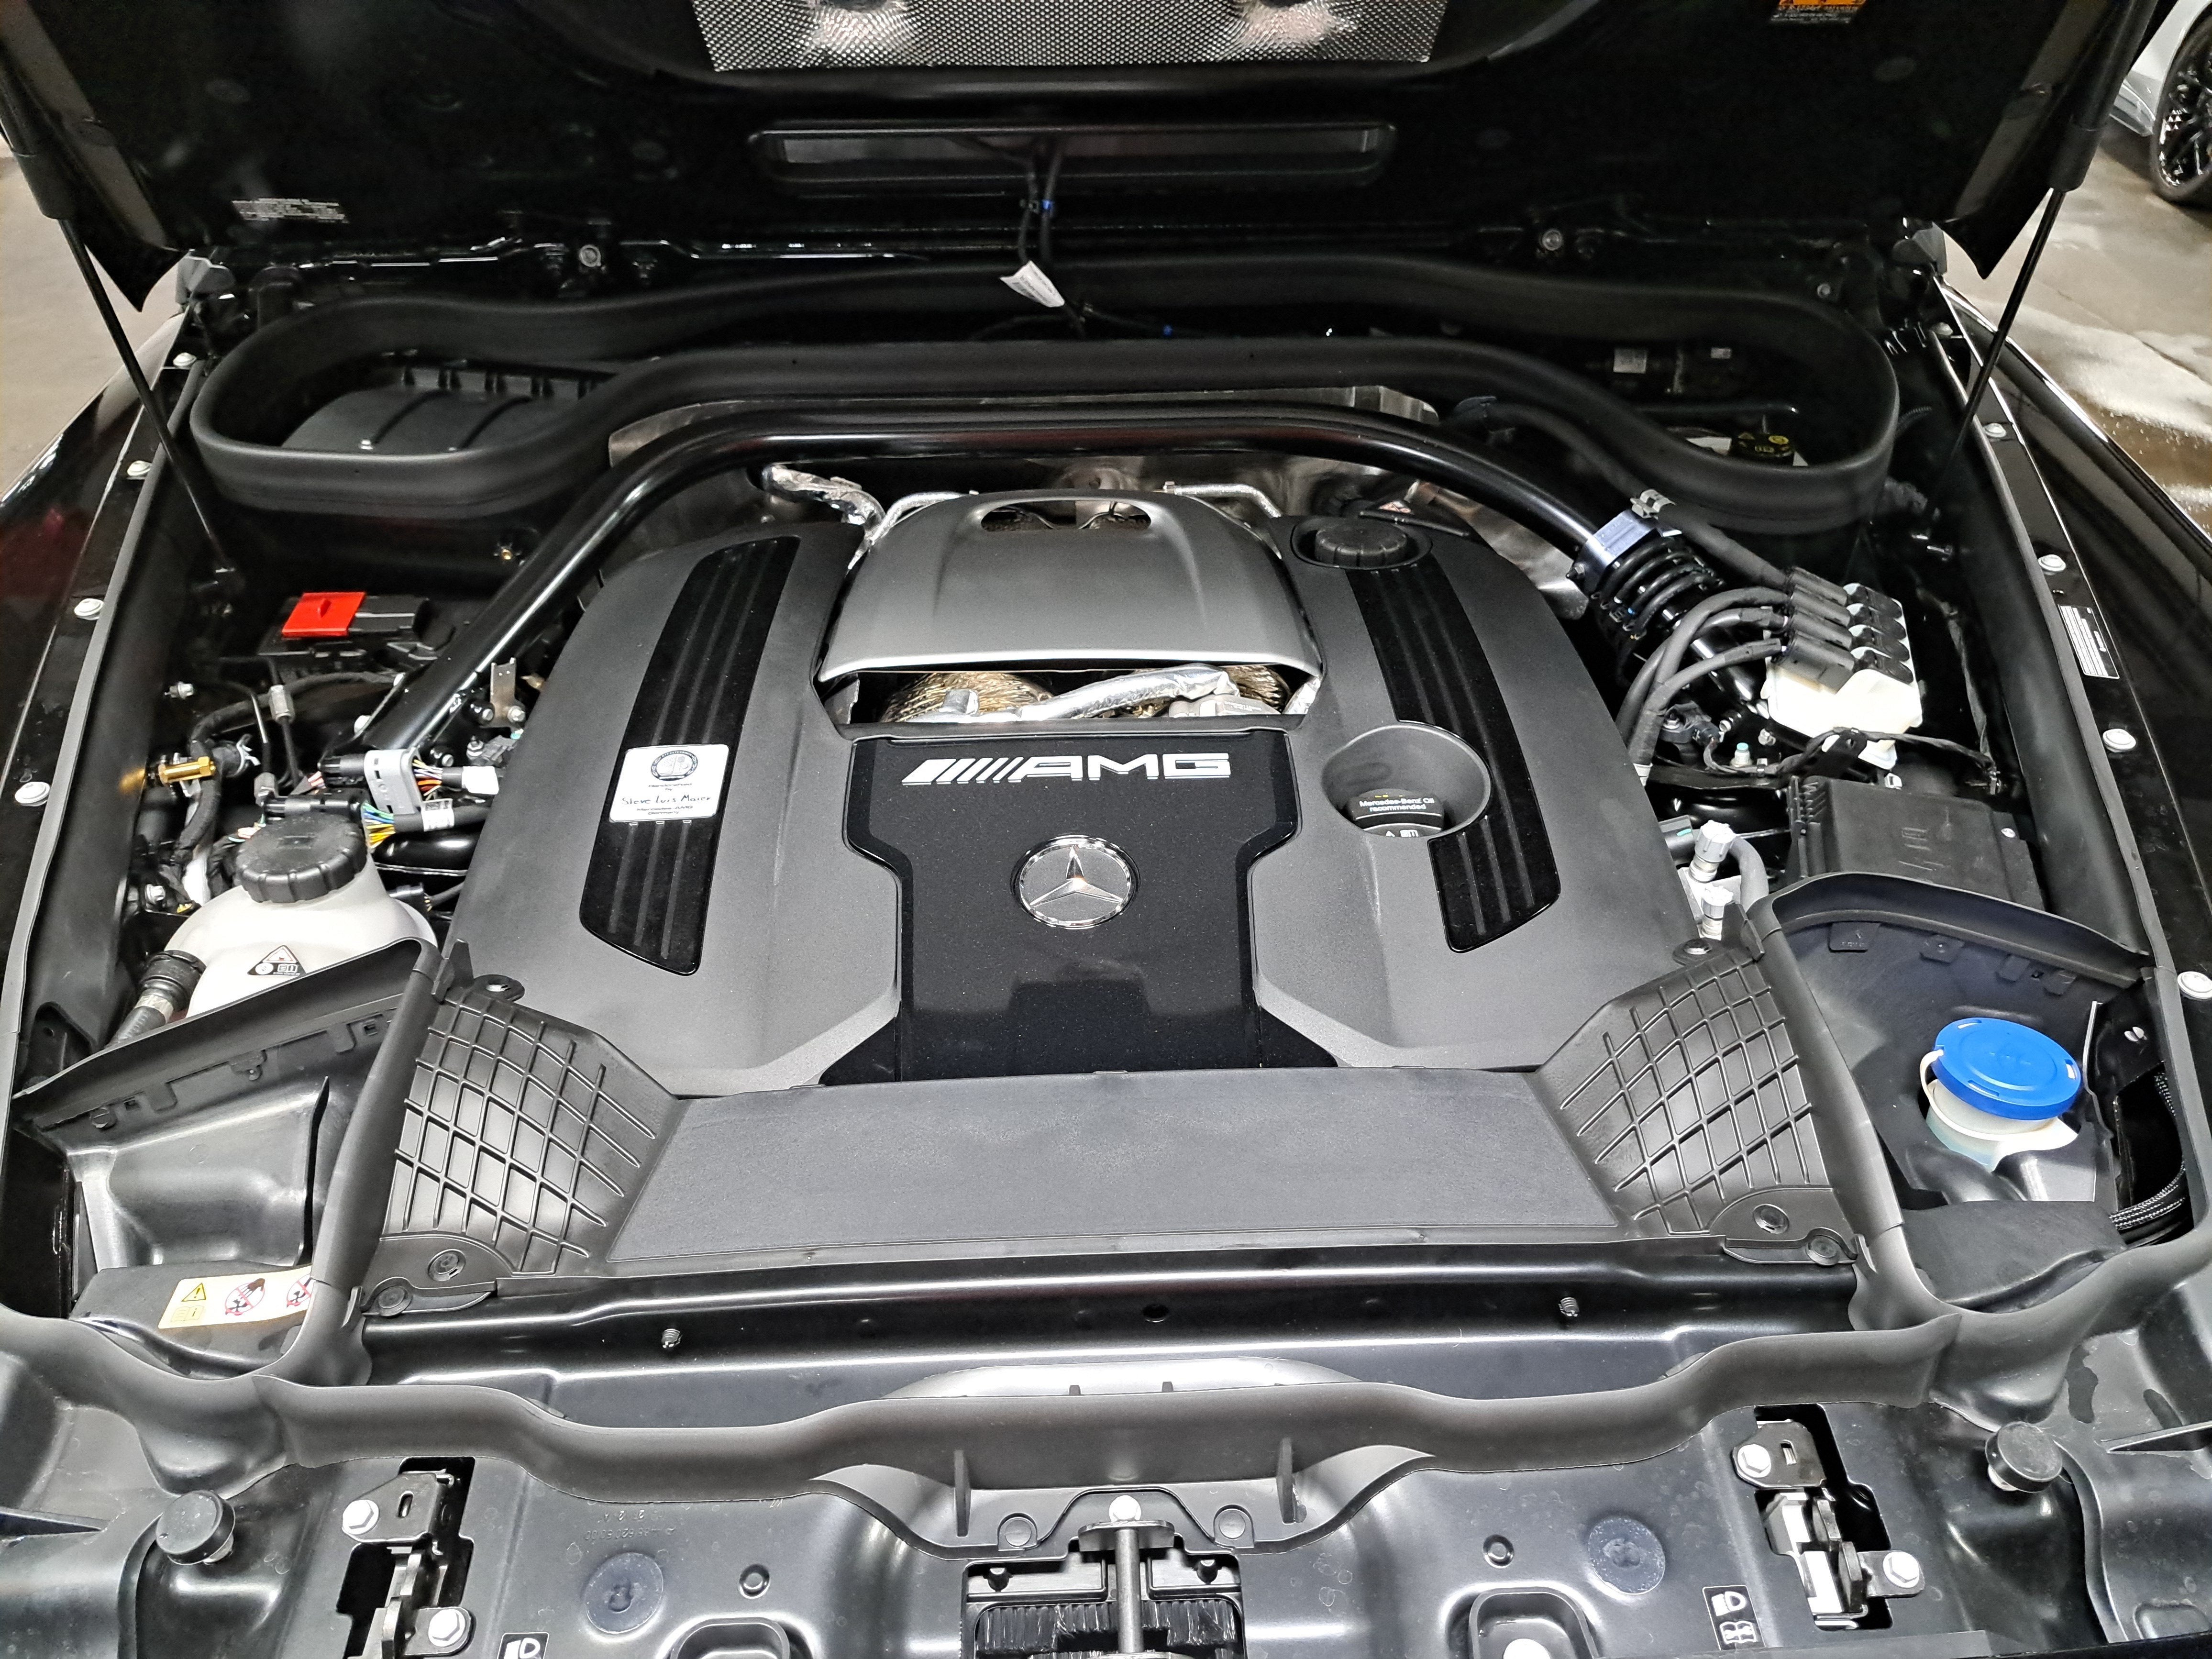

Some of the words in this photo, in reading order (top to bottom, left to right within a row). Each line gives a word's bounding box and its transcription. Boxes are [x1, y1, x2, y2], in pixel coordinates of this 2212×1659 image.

[1007, 752, 1231, 783] AMG
[1359, 797, 1422, 807] Mercedes-Benz
[1369, 804, 1427, 812] recommended
